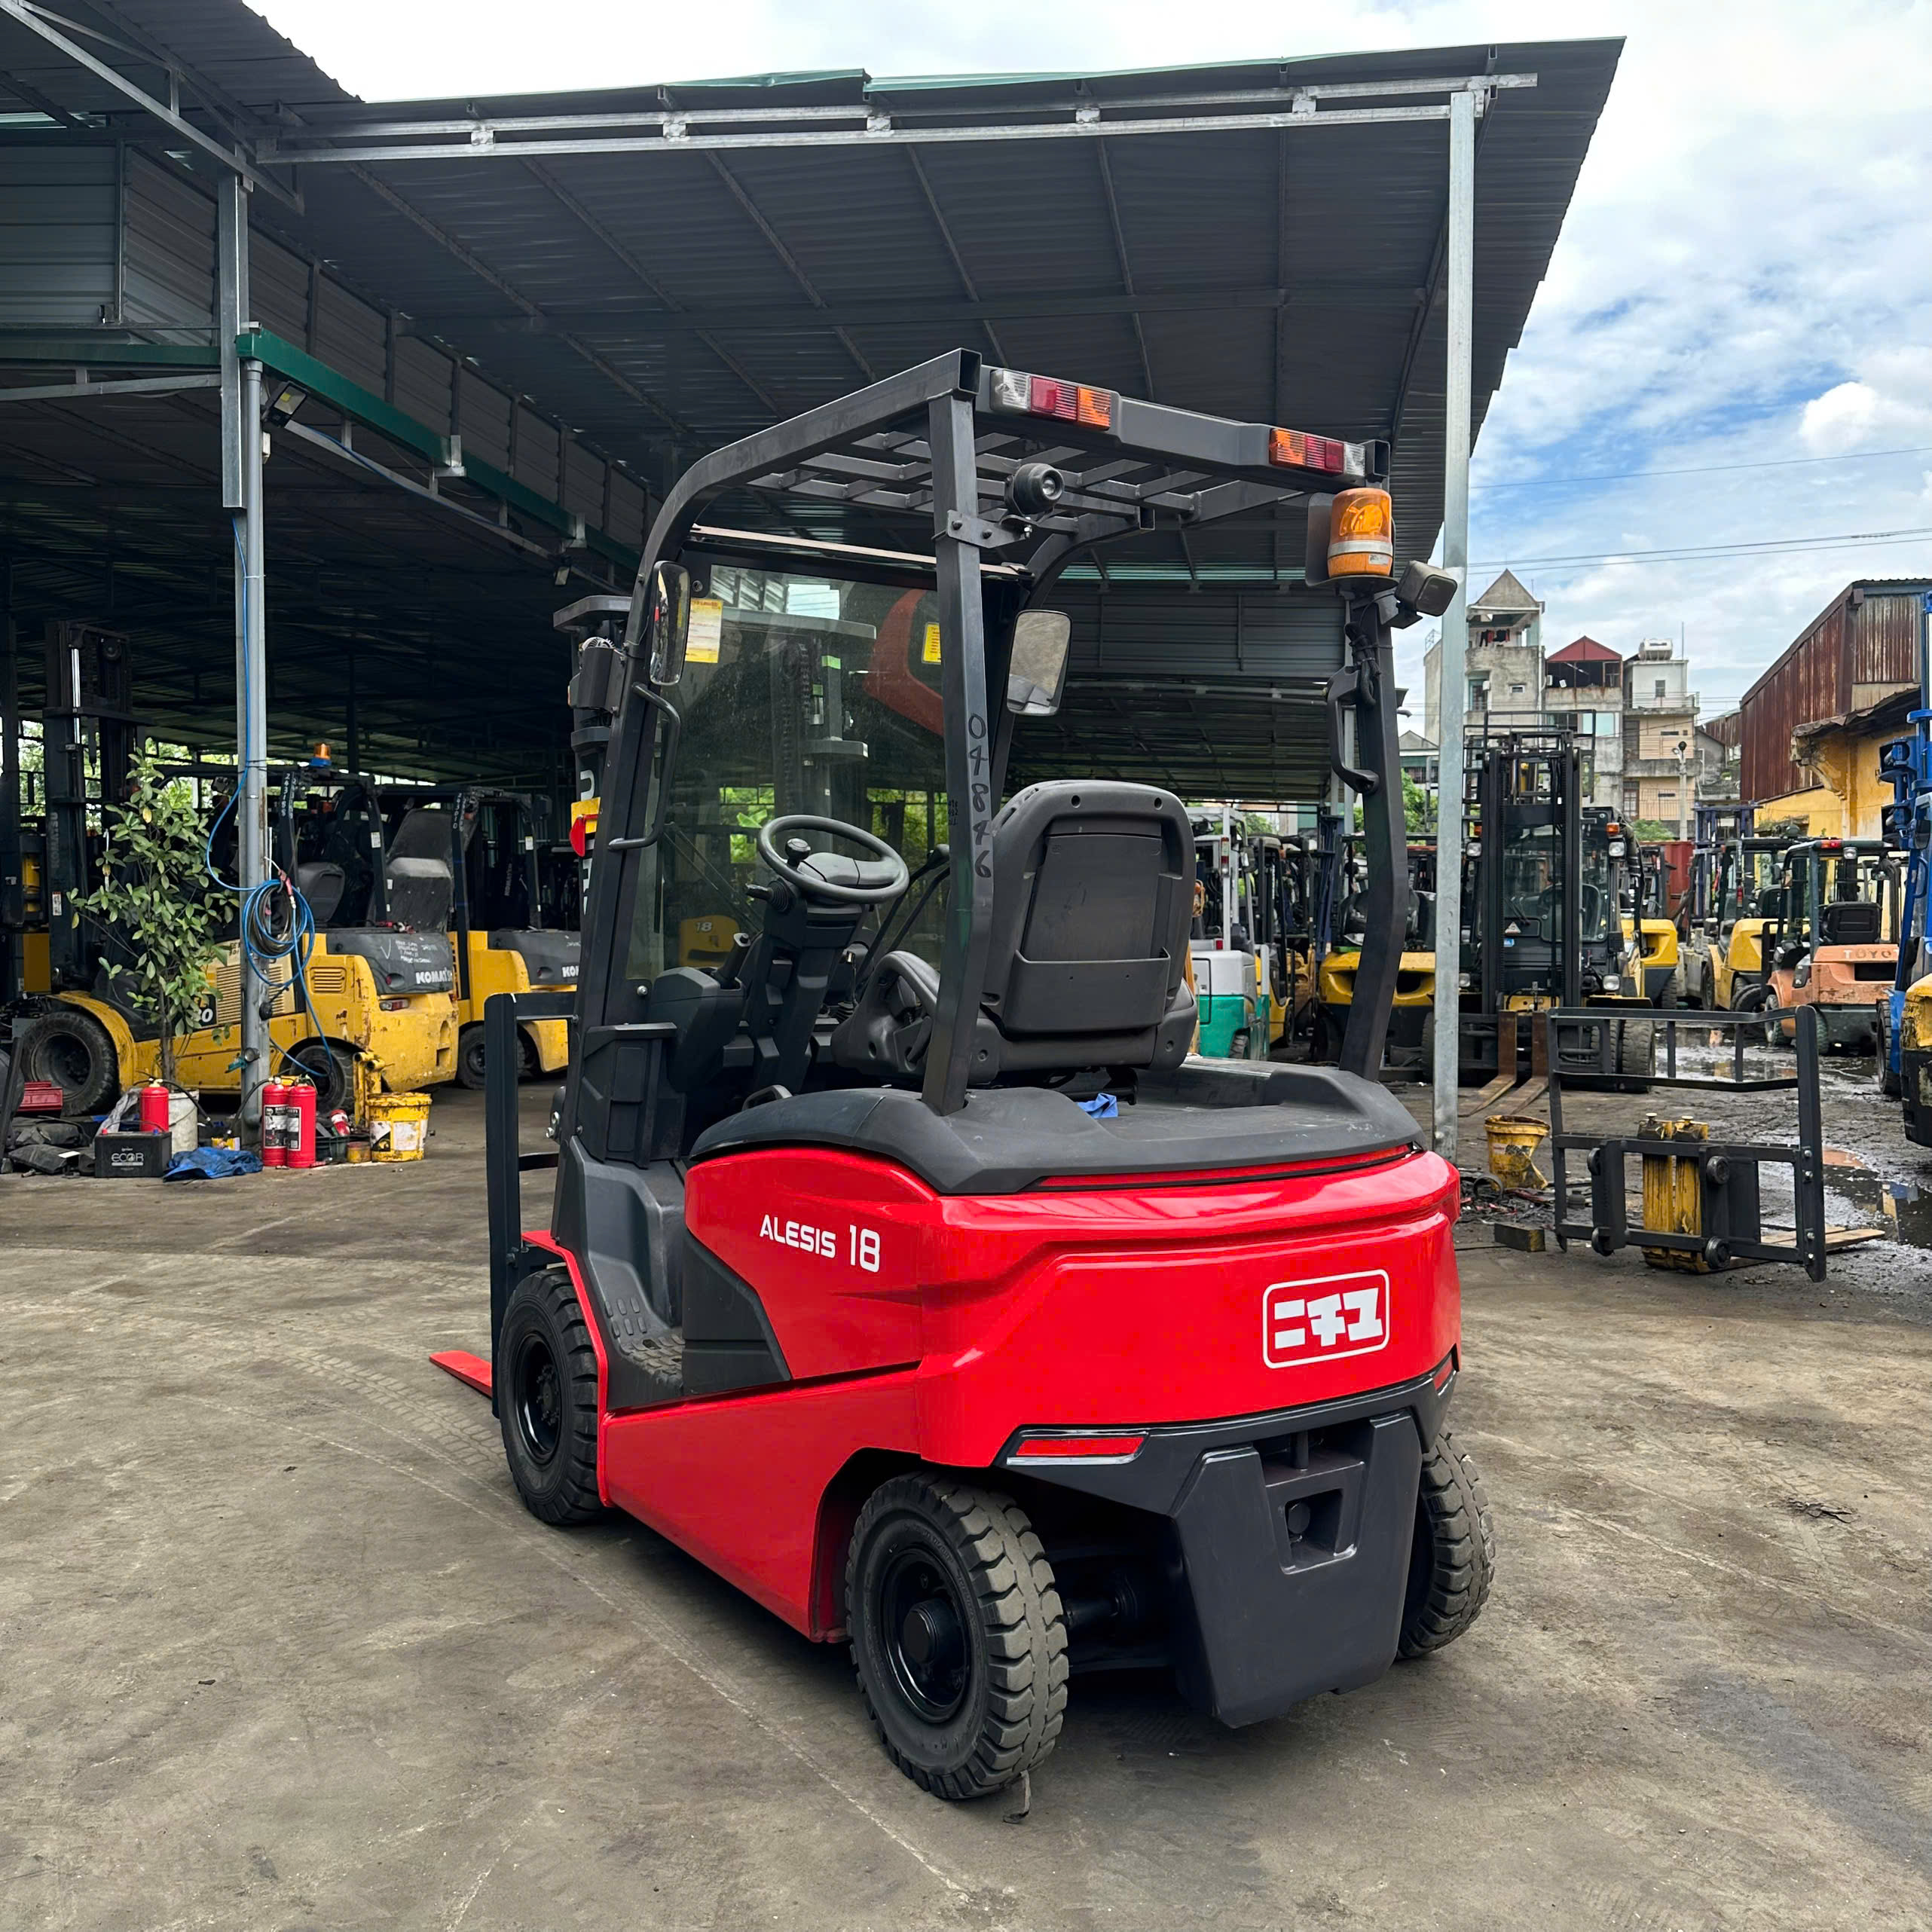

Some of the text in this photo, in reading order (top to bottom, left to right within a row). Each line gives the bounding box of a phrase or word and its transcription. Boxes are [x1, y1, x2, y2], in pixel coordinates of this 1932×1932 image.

[968, 713, 992, 879] 04846
[50, 812, 60, 868] KOMATSU
[760, 1214, 881, 1273] ALESIS 18
[1273, 1287, 1384, 1350] ニチユ
